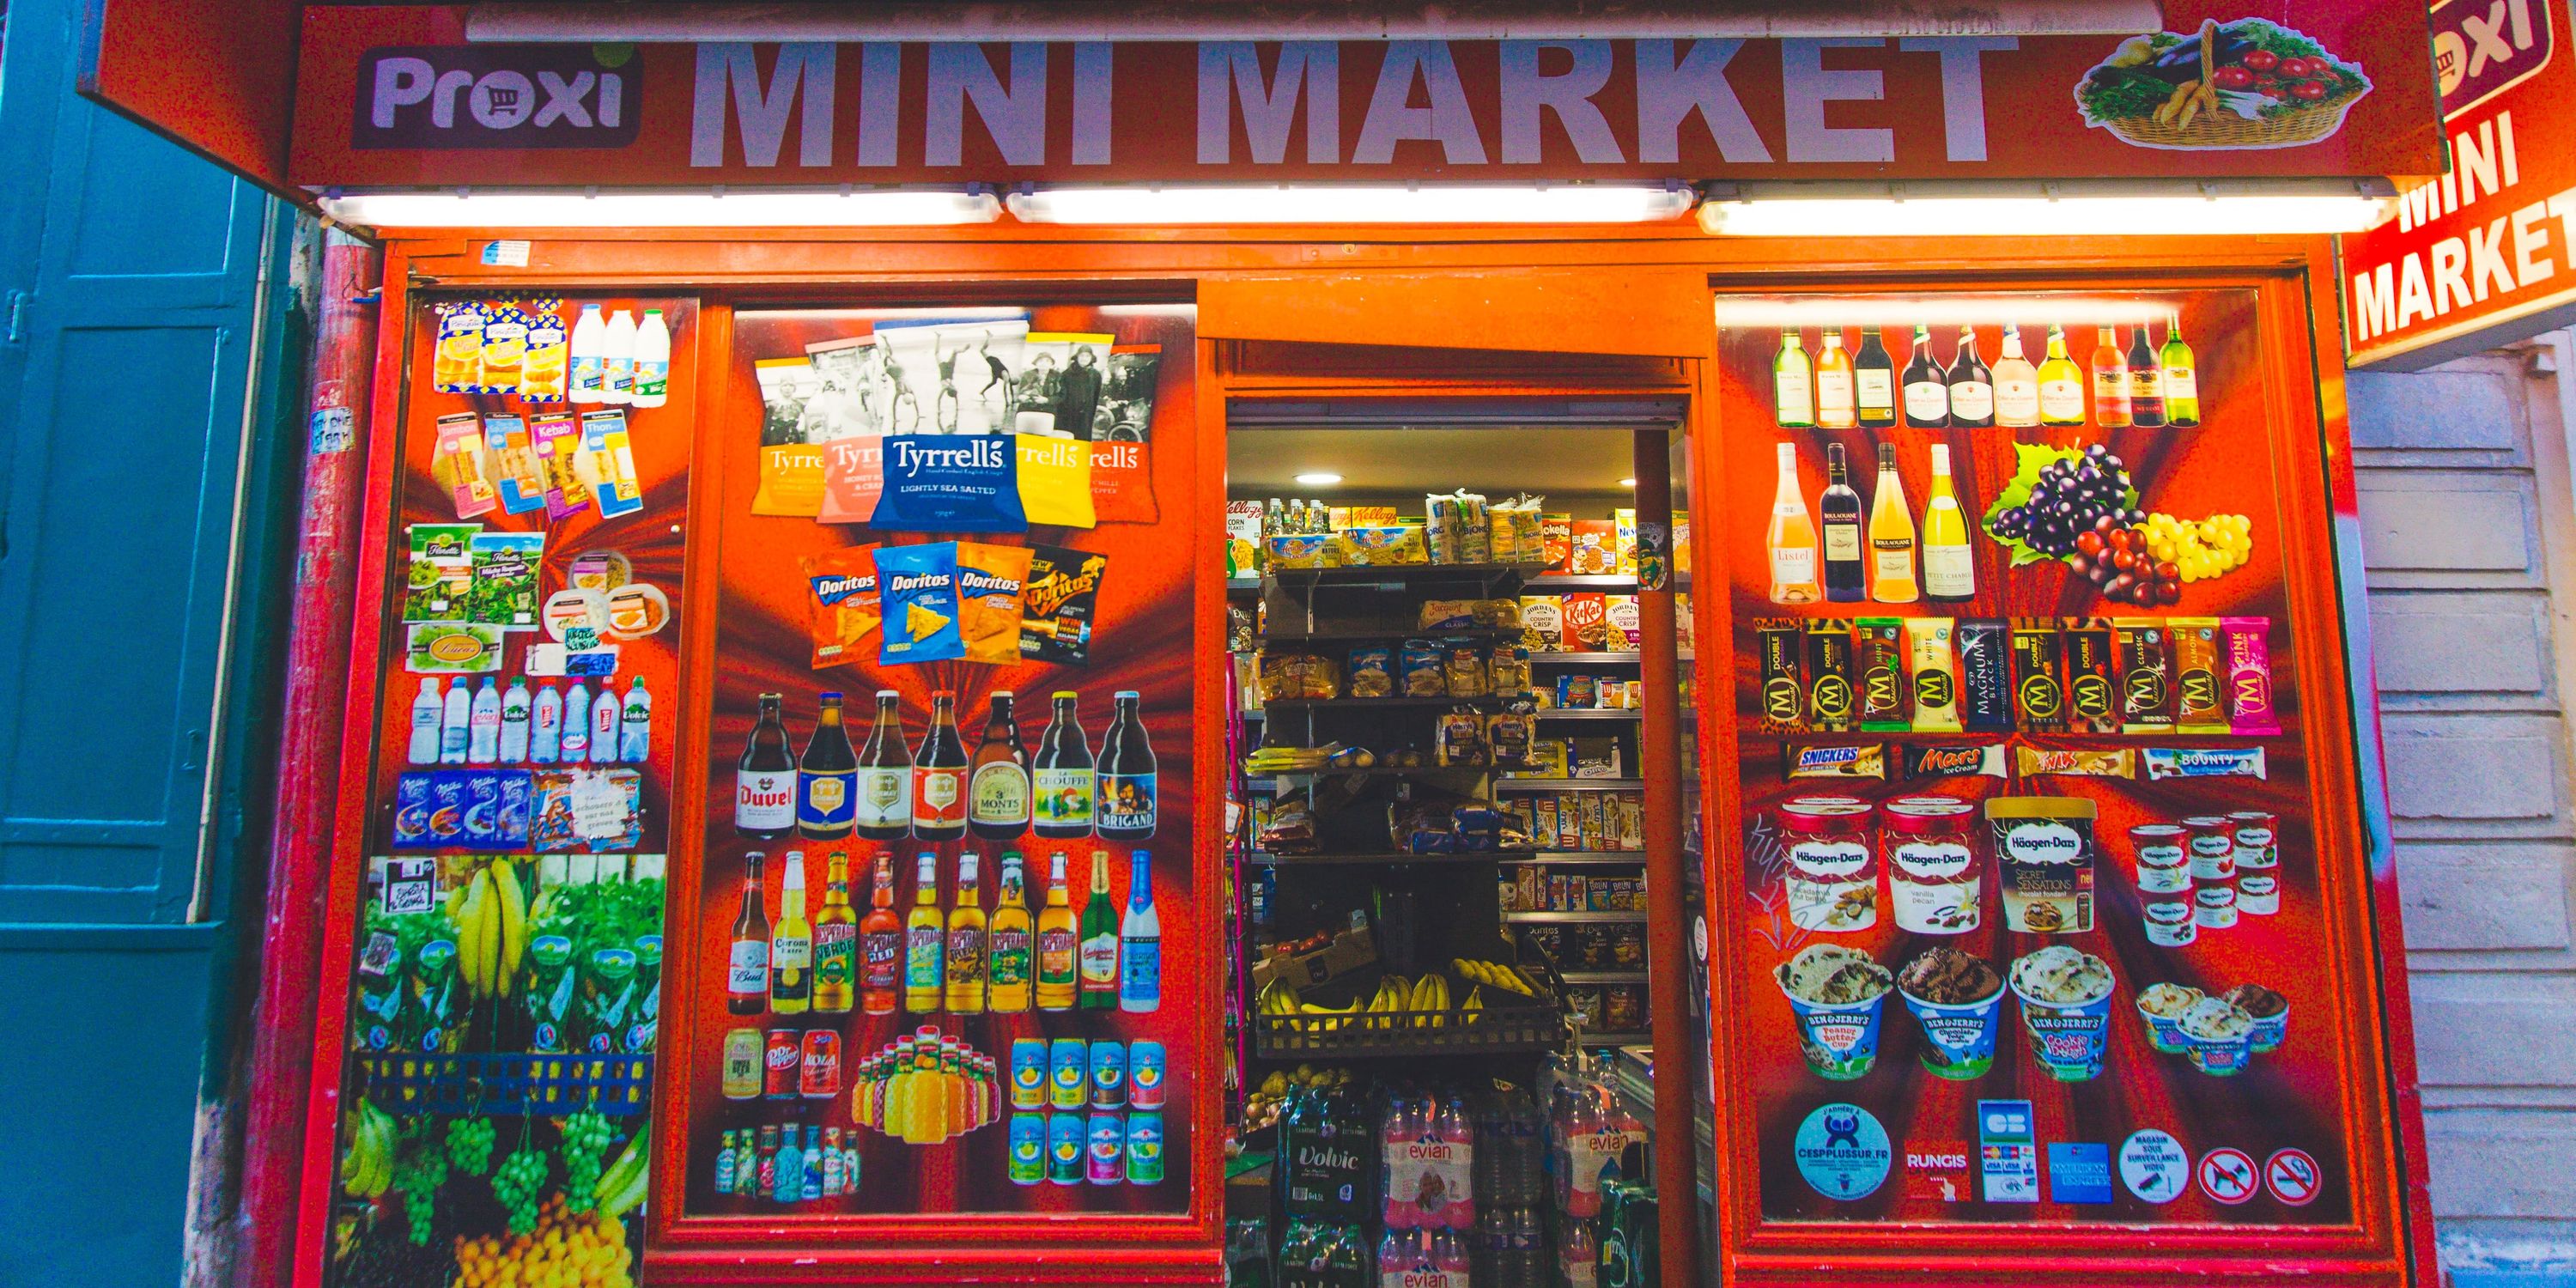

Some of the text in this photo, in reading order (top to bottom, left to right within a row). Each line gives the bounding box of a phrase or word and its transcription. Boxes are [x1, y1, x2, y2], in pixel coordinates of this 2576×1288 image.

[373, 46, 629, 129] Proxi
[690, 37, 2020, 168] MINI MARKET
[2354, 186, 2576, 342] MARKET
[538, 423, 571, 437] Kebab
[587, 423, 611, 433] Thon
[901, 484, 996, 495] LIGHTLY SEA SALTED
[1777, 550, 1809, 561] Listel
[818, 575, 876, 595] Doritos
[891, 572, 951, 591] Doritos
[961, 572, 1021, 592] Doritos
[1030, 573, 1094, 603] Doritos
[1527, 605, 1556, 615] JORDANS
[1569, 601, 1601, 624] KitKat
[2234, 632, 2243, 663] PINK
[1975, 641, 1990, 715] MAGNUM
[1604, 684, 1612, 694] LU
[1801, 746, 1859, 764] SNICKERS
[1918, 749, 1981, 773] Mars
[2182, 754, 2234, 767] BOUNTY
[404, 777, 429, 792] Milka
[435, 782, 463, 793] Milka
[470, 777, 496, 787] Milka
[501, 777, 528, 788] Milka
[1039, 776, 1089, 786] CHOUFFE
[741, 785, 792, 807] Duvel
[996, 790, 1004, 799] 3
[981, 799, 1020, 808] MONTS
[1103, 813, 1153, 826] BRIGAND
[2012, 836, 2075, 851] Häagen-Dazs
[1796, 850, 1862, 865] Häagen-Dazs
[1901, 852, 1965, 866] Häagen-Dazs
[775, 938, 809, 948] Corona
[817, 939, 854, 958] VERDE
[868, 947, 895, 963] RED
[735, 969, 764, 983] Bud
[1823, 1027, 1856, 1036] Peanut
[1824, 1035, 1856, 1043] Butter
[2047, 1035, 2088, 1047] Cookie
[777, 1046, 791, 1055] Dr
[769, 1049, 798, 1068] Pepper
[805, 1053, 835, 1066] KOLA
[1589, 1133, 1629, 1151] evian
[2135, 1136, 2168, 1145] MAGASIN
[1409, 1144, 1451, 1159] evian
[2143, 1145, 2163, 1154] SOUS
[1299, 1146, 1359, 1170] Volvic
[1907, 1154, 1967, 1168] RUNGIS
[2127, 1153, 2180, 1163] SURVEILLANCE
[2052, 1163, 2107, 1175] AMERICAN
[2063, 1176, 2111, 1187] EXPRESS
[1405, 1273, 1448, 1288] evian
